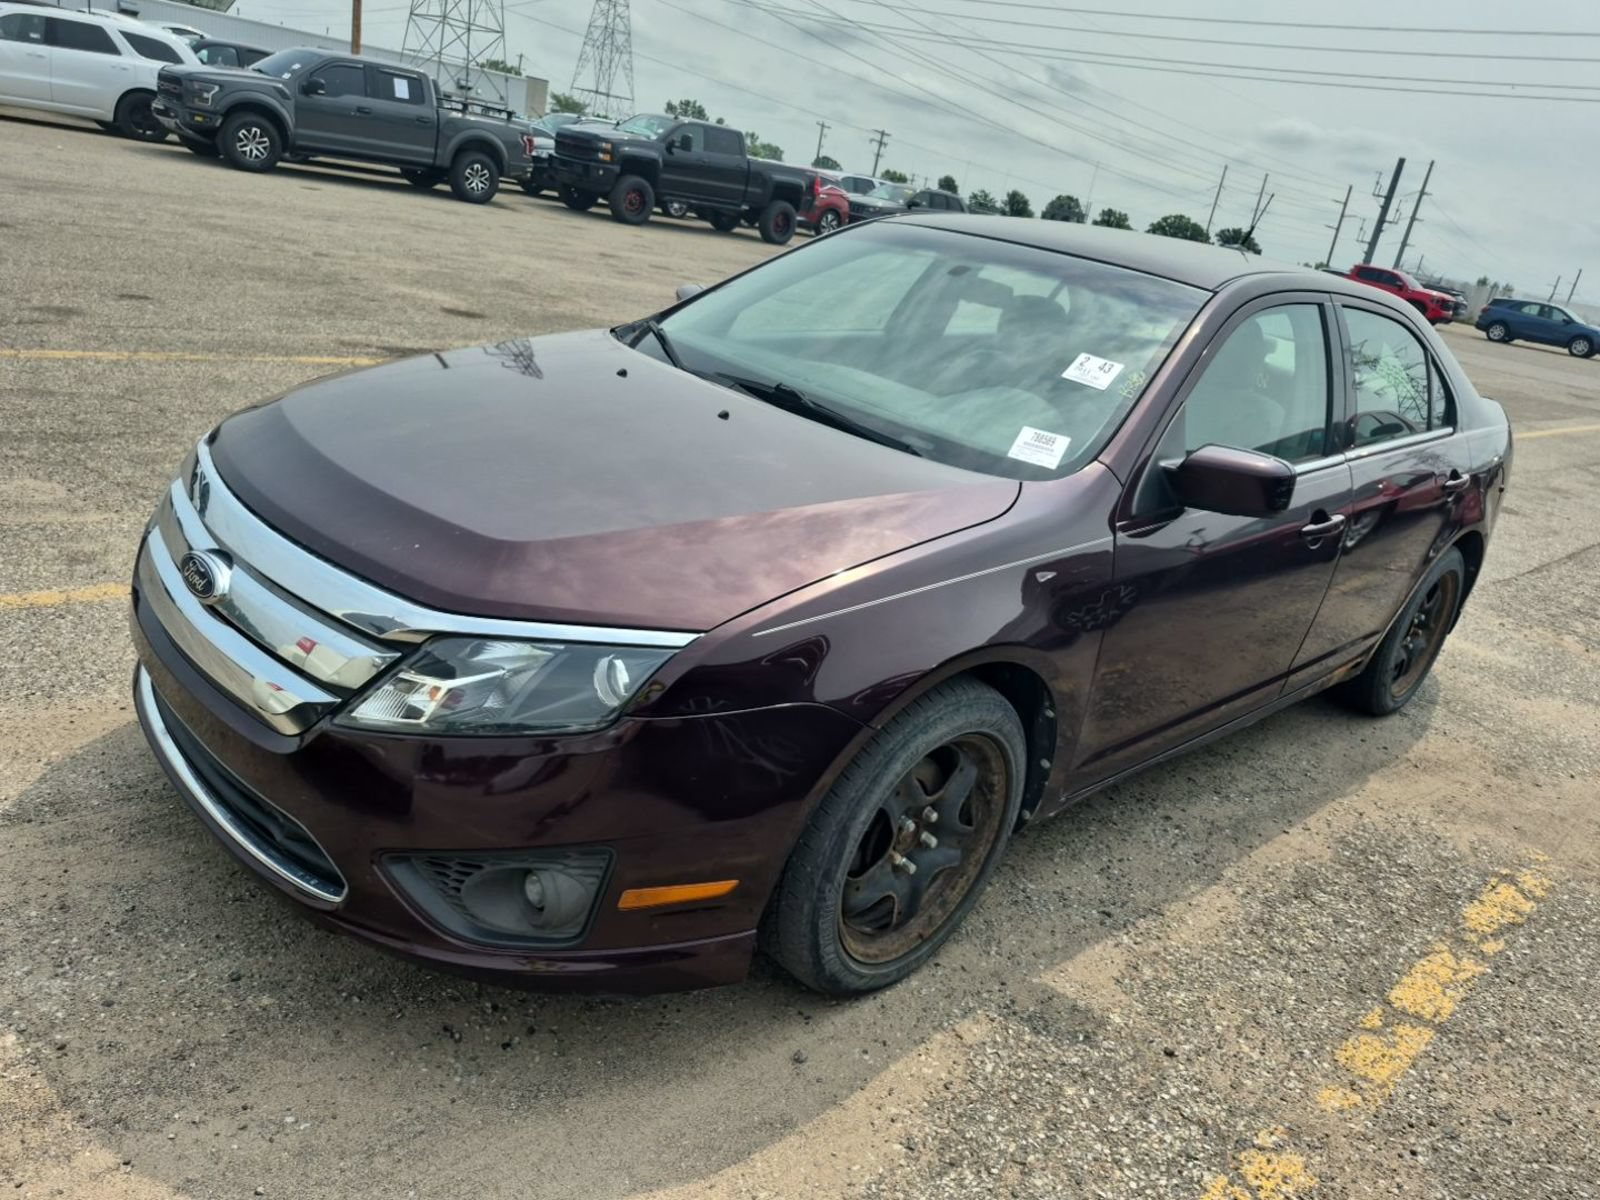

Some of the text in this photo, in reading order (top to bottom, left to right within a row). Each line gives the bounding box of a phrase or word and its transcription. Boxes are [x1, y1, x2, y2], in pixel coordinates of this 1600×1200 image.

[1079, 356, 1091, 368] 2
[1098, 362, 1115, 374] 43
[184, 559, 208, 591] Ford
